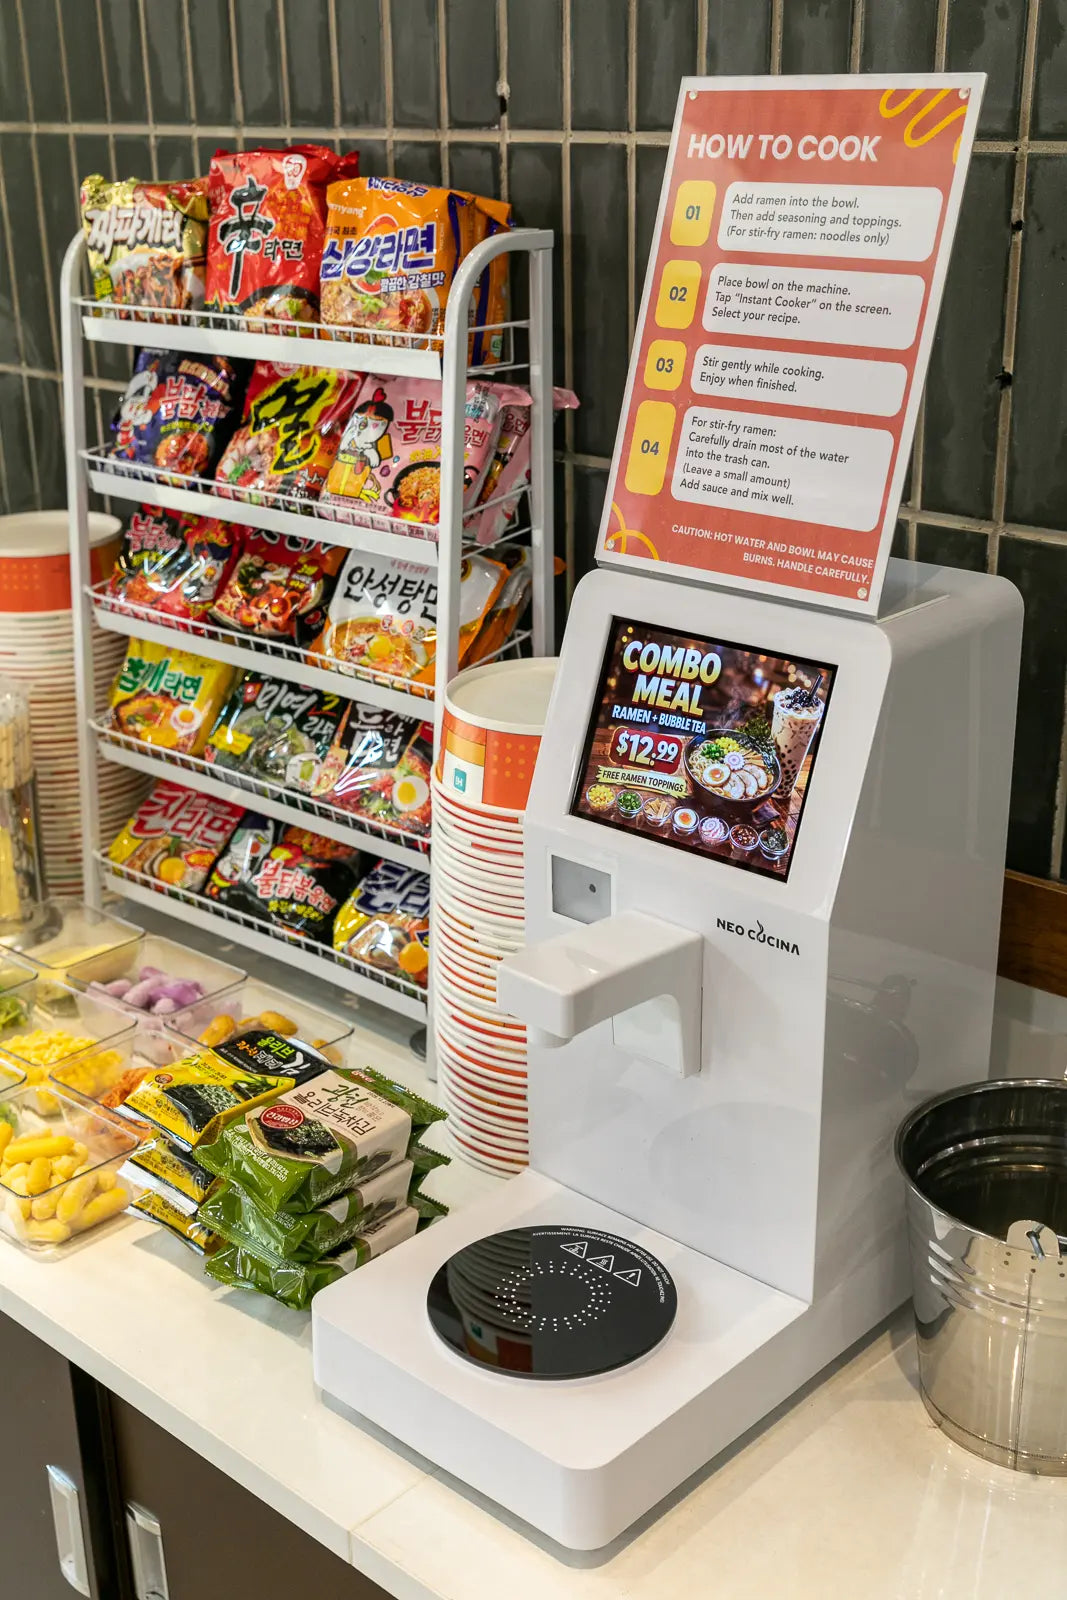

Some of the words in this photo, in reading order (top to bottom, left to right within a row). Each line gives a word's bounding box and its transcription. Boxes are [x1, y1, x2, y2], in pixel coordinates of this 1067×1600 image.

[687, 133, 754, 160] HOW
[758, 134, 793, 160] TO
[798, 135, 882, 162] COOK
[685, 204, 701, 221] 01
[731, 193, 754, 205] Add
[755, 197, 787, 206] ramen
[788, 195, 809, 207] into
[811, 195, 829, 208] the
[830, 196, 859, 209] bowl.
[730, 208, 754, 221] Then
[755, 210, 776, 222] add
[777, 212, 827, 227] seasoning
[829, 213, 850, 225] and
[852, 215, 902, 230] toppings.
[218, 175, 275, 300] 辛
[726, 224, 747, 237] (For
[747, 225, 781, 241] stir-fry
[782, 230, 817, 240] ramen:
[819, 229, 861, 242] noodles
[863, 231, 890, 247] only)
[263, 238, 304, 261] 라면
[320, 222, 437, 281] 삼양라면
[407, 271, 447, 291] 감칠맛
[669, 286, 688, 302] 02
[717, 275, 743, 288] Place
[744, 276, 770, 289] bowl
[771, 281, 784, 290] on
[786, 279, 804, 292] the
[805, 282, 851, 295] machine.
[711, 306, 741, 319] Select
[741, 311, 766, 322] your
[766, 311, 801, 326] recipe.
[715, 290, 732, 305] Tap
[818, 301, 832, 310] on
[834, 299, 852, 312] the
[854, 304, 892, 315] screen.
[656, 358, 674, 373] 03
[702, 355, 720, 367] Stir
[720, 359, 752, 374] gently
[753, 361, 780, 374] while
[781, 365, 824, 382] cooking.
[699, 371, 726, 387] Enjoy
[728, 374, 754, 387] when
[756, 376, 797, 393] finished.
[691, 415, 708, 427] For
[708, 419, 741, 435] stir-fry
[742, 425, 777, 437] ramen:
[640, 439, 660, 456] 04
[685, 446, 704, 459] into
[706, 449, 722, 462] the
[724, 453, 748, 465] trash
[750, 458, 770, 469] can.
[688, 431, 730, 449] Carefully
[731, 436, 757, 451] drain
[758, 443, 784, 455] most
[785, 445, 799, 456] of
[799, 446, 817, 459] the
[819, 451, 849, 464] water
[682, 462, 713, 476] (Leave
[714, 469, 721, 478] a
[722, 470, 749, 482] small
[749, 475, 791, 490] amount)
[679, 477, 700, 490] Add
[701, 483, 728, 495] sauce
[729, 487, 750, 498] and
[750, 489, 769, 502] mix
[771, 493, 794, 506] well.
[671, 523, 713, 540] CAUTION:
[713, 531, 734, 543] HOT
[734, 534, 766, 549] WATER
[765, 541, 788, 553] AND
[787, 544, 816, 558] BOWL
[816, 549, 840, 562] MAY
[841, 554, 875, 570] CAUSE
[742, 551, 775, 567] BURNS.
[776, 558, 814, 574] HANDLE
[815, 566, 870, 585] CAREFULLY.
[622, 639, 722, 684] COMBO
[117, 655, 203, 702] 참깨라면
[631, 674, 704, 716] MEAL
[611, 704, 652, 724] RAMEN
[658, 712, 691, 732] BUBBLE
[691, 721, 707, 735] TEA
[615, 729, 679, 767] $12.99
[602, 769, 621, 781] FREE
[620, 771, 648, 785] RAMEN
[648, 775, 684, 793] TOPPINGS
[132, 788, 239, 847] 진라면
[252, 859, 338, 914] 불닭볶음면
[716, 917, 745, 936] NEO
[747, 921, 800, 956] CUCINA
[292, 1090, 377, 1137] 올리브녹차김
